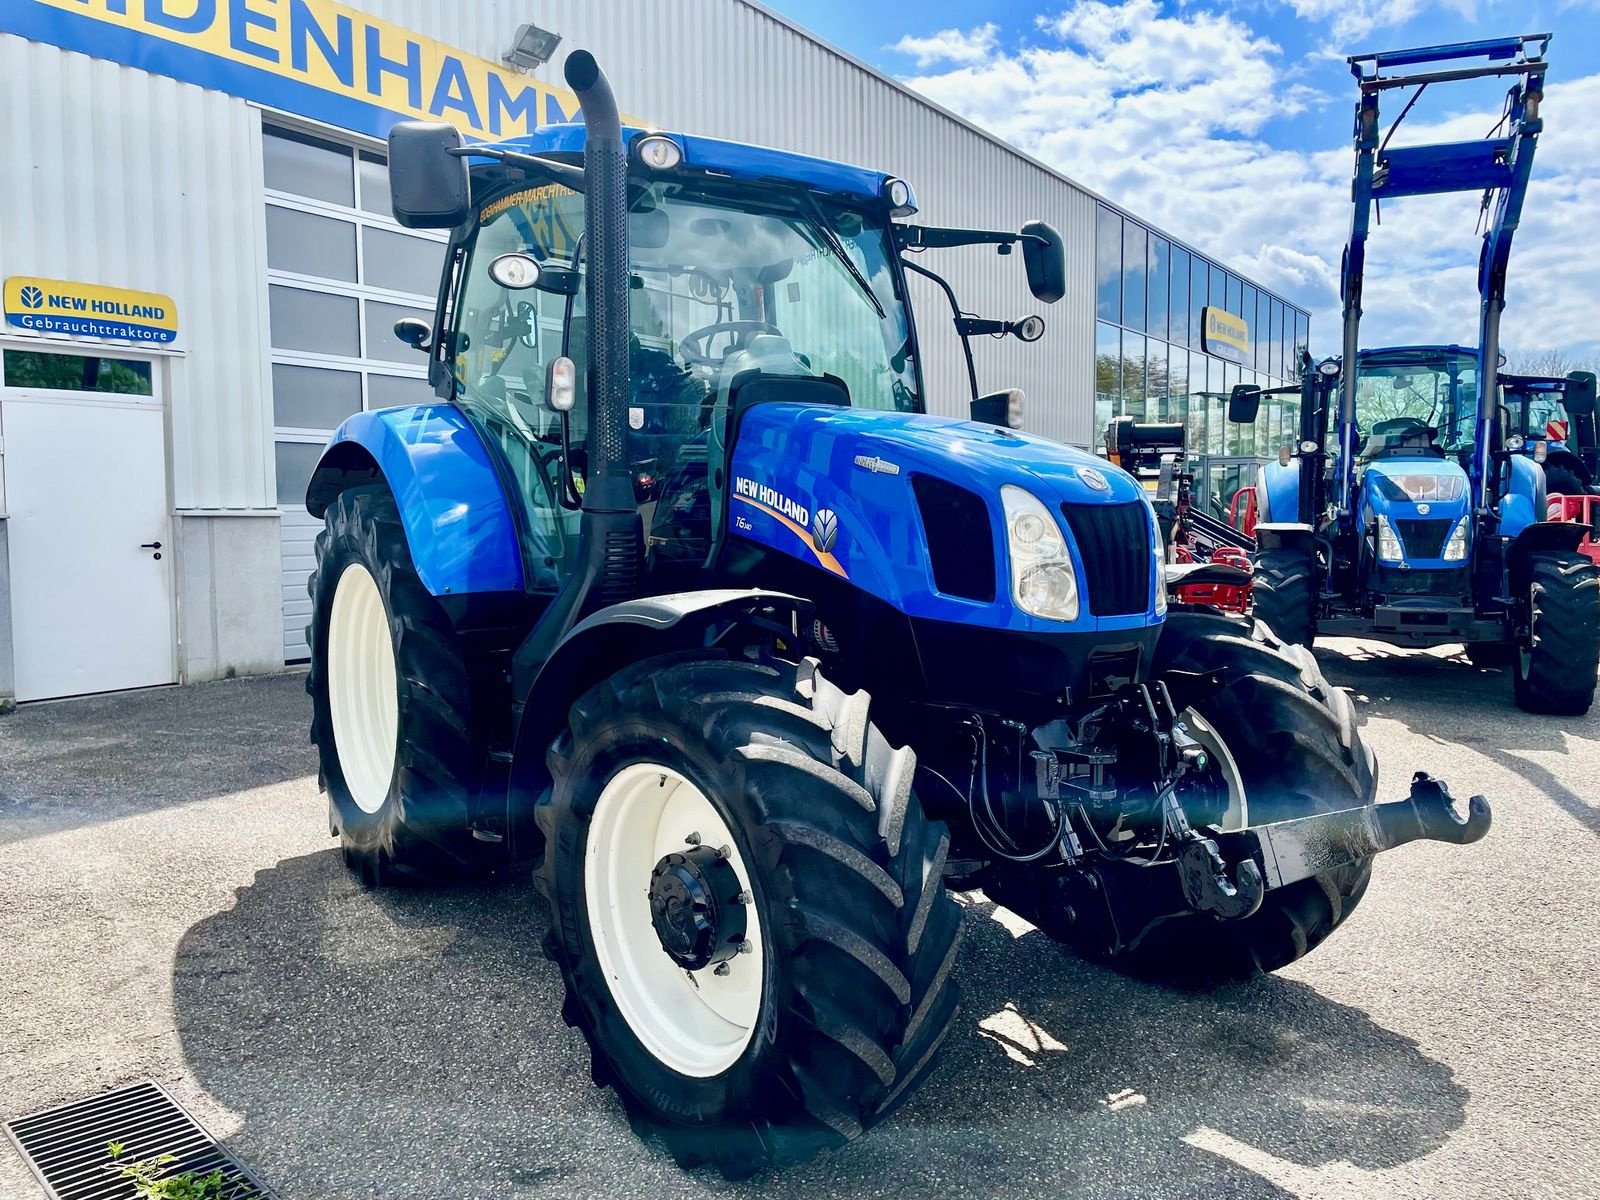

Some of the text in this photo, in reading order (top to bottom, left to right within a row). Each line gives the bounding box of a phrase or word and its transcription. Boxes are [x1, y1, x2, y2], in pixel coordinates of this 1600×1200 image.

[76, 0, 585, 138] ENHAM
[48, 294, 165, 320] NEW HOLLAND
[21, 315, 168, 341] Gebrauchttraktore
[736, 476, 809, 527] NEW HOLLAND
